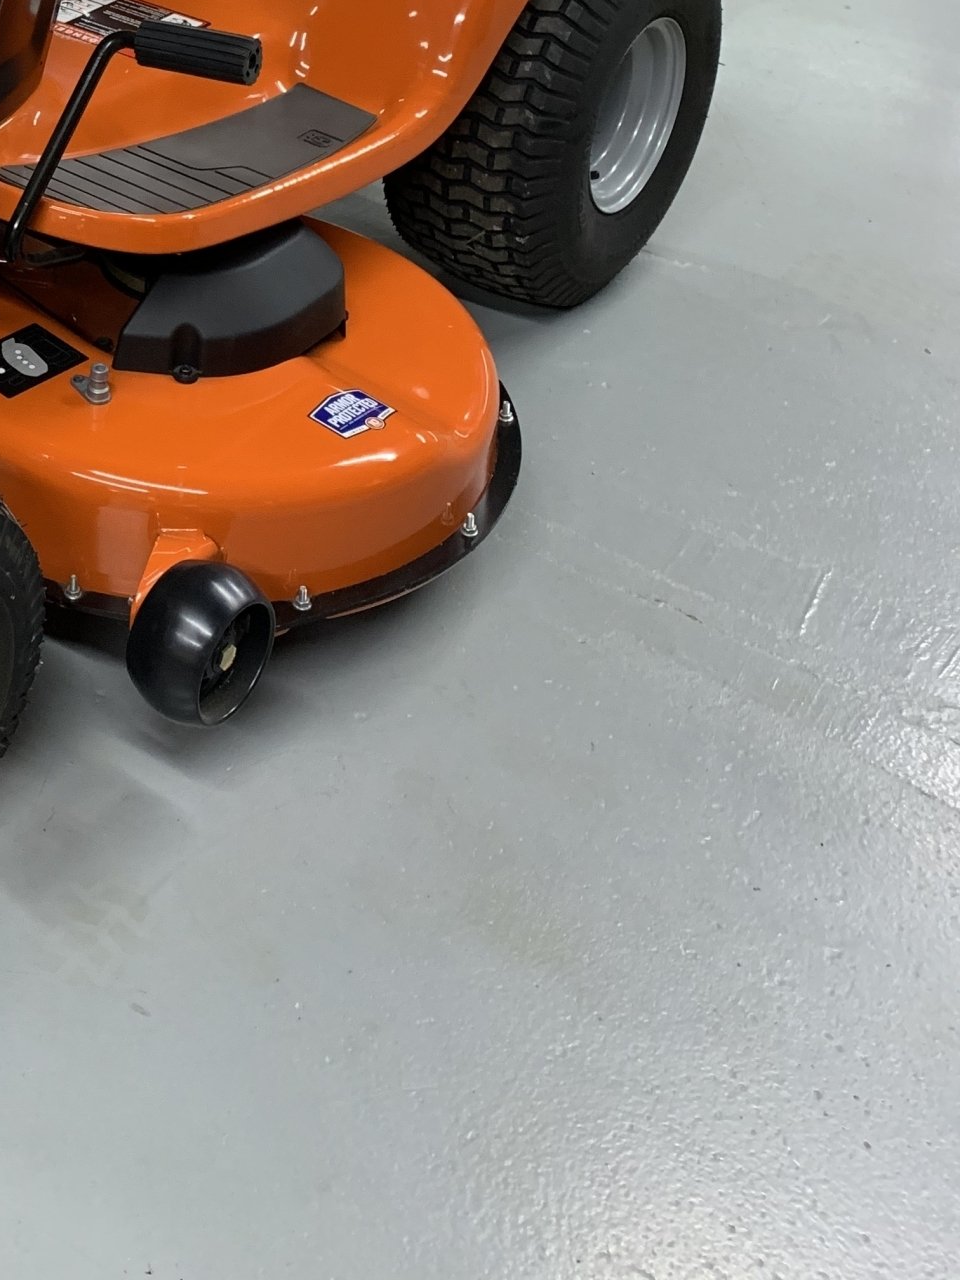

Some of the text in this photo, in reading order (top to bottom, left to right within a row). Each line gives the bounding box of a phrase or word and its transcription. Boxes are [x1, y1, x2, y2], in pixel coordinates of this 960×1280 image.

[54, 23, 102, 44] DANGE
[323, 393, 361, 416] ARMOR
[327, 397, 379, 428] PROTECTED
